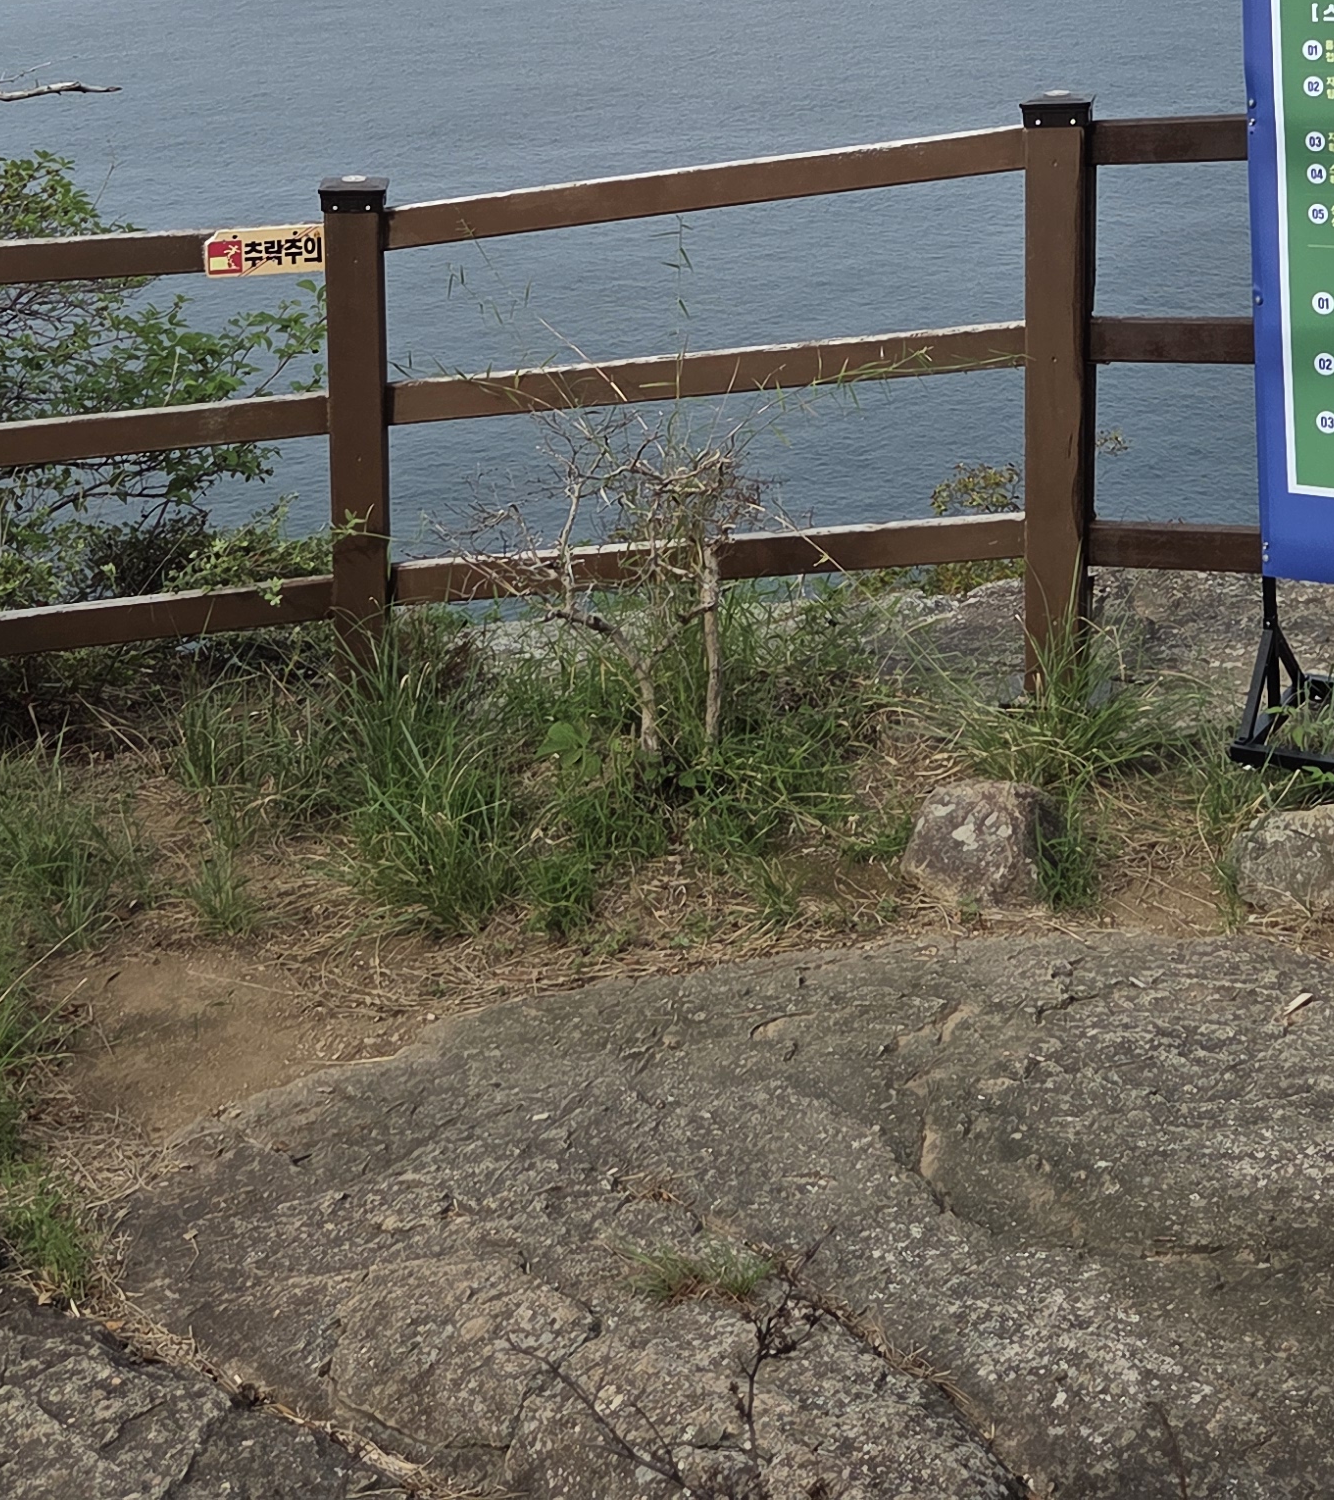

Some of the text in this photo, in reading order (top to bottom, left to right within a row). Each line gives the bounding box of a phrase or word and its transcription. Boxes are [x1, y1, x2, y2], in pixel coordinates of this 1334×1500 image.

[1308, 45, 1317, 55] 01
[1308, 81, 1320, 91] 02
[1309, 136, 1321, 147] 03
[1311, 168, 1323, 179] 04
[1312, 209, 1324, 219] 05
[244, 237, 322, 267] 추락주의
[1318, 297, 1329, 310] 01
[1319, 358, 1333, 371] 02
[1320, 416, 1334, 428] 03
